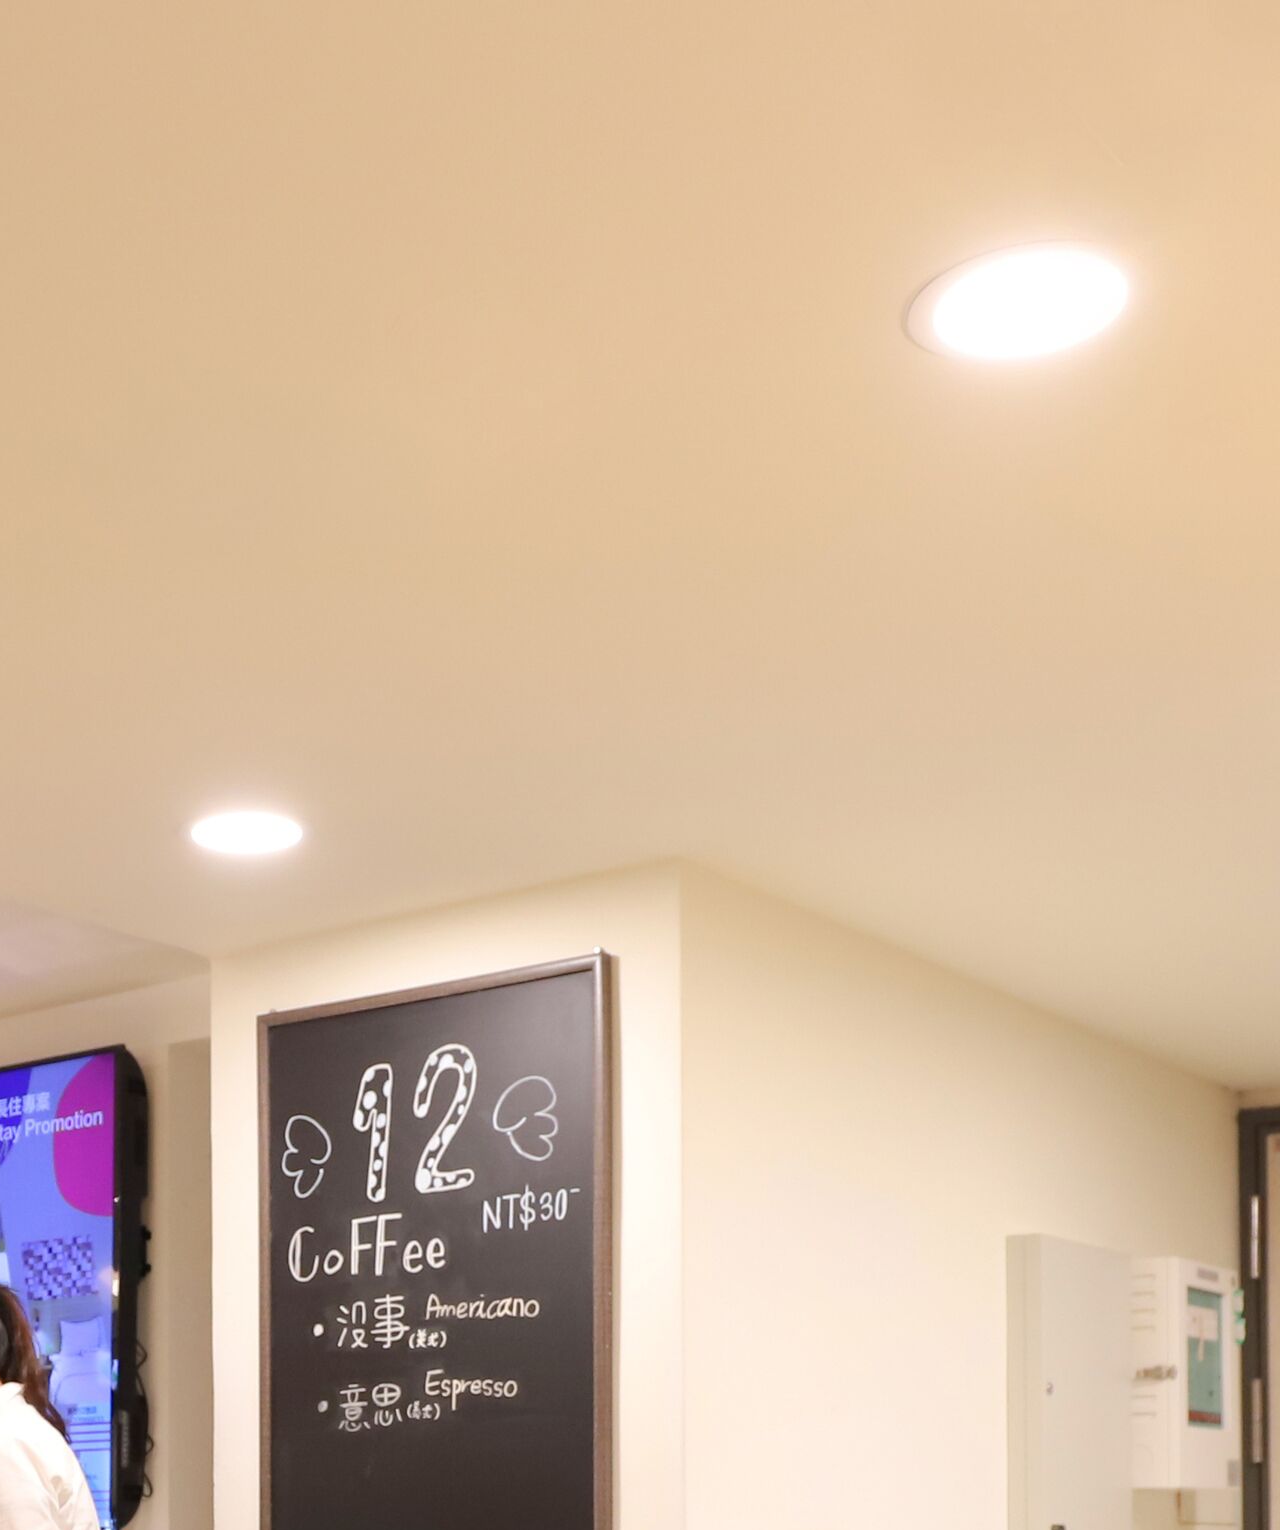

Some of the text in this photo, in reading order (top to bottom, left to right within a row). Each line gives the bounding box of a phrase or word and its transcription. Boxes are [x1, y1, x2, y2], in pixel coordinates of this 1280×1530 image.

[24, 1109, 105, 1138] Promotion
[352, 1042, 476, 1203] 12
[425, 1293, 540, 1321] Americano
[424, 1369, 519, 1412] Espresso
